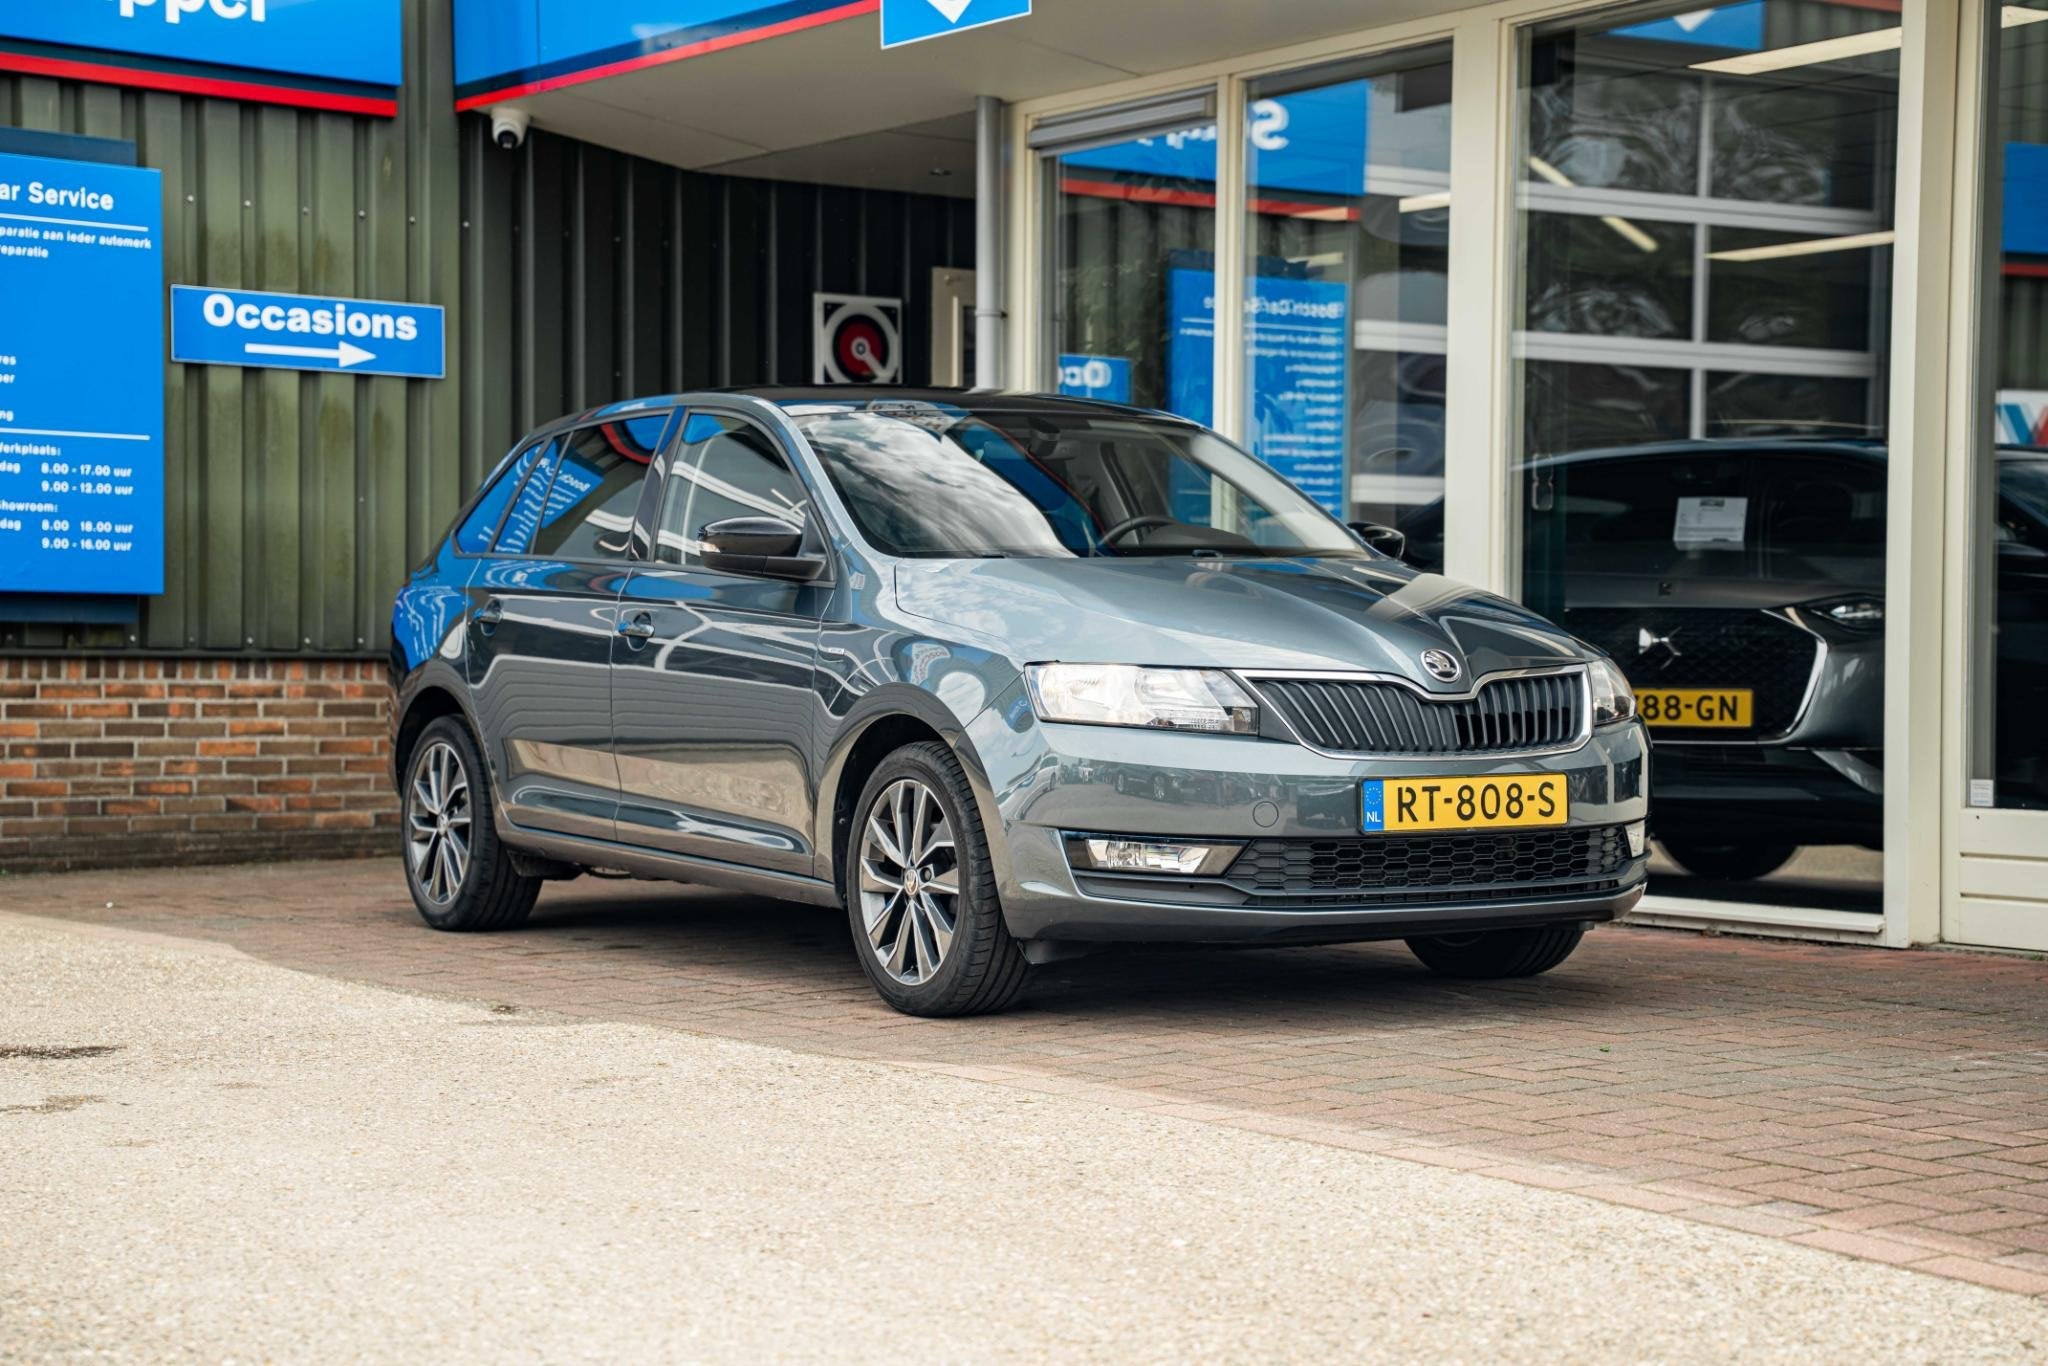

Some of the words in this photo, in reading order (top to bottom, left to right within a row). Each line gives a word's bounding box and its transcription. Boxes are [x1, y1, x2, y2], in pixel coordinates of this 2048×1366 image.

[28, 181, 114, 211] Service
[66, 231, 96, 245] ieder
[99, 234, 152, 250] automerk
[0, 244, 49, 259] eparatie
[203, 293, 418, 341] Occasions
[80, 464, 111, 477] 17.00
[113, 468, 132, 477] uur
[114, 486, 133, 495] uur
[0, 499, 58, 513] howroom:
[114, 524, 133, 533] uur
[113, 542, 132, 551] uur
[1635, 694, 1739, 721] 88-GN
[1366, 811, 1382, 823] NL
[1397, 781, 1556, 823] RT-808-S
